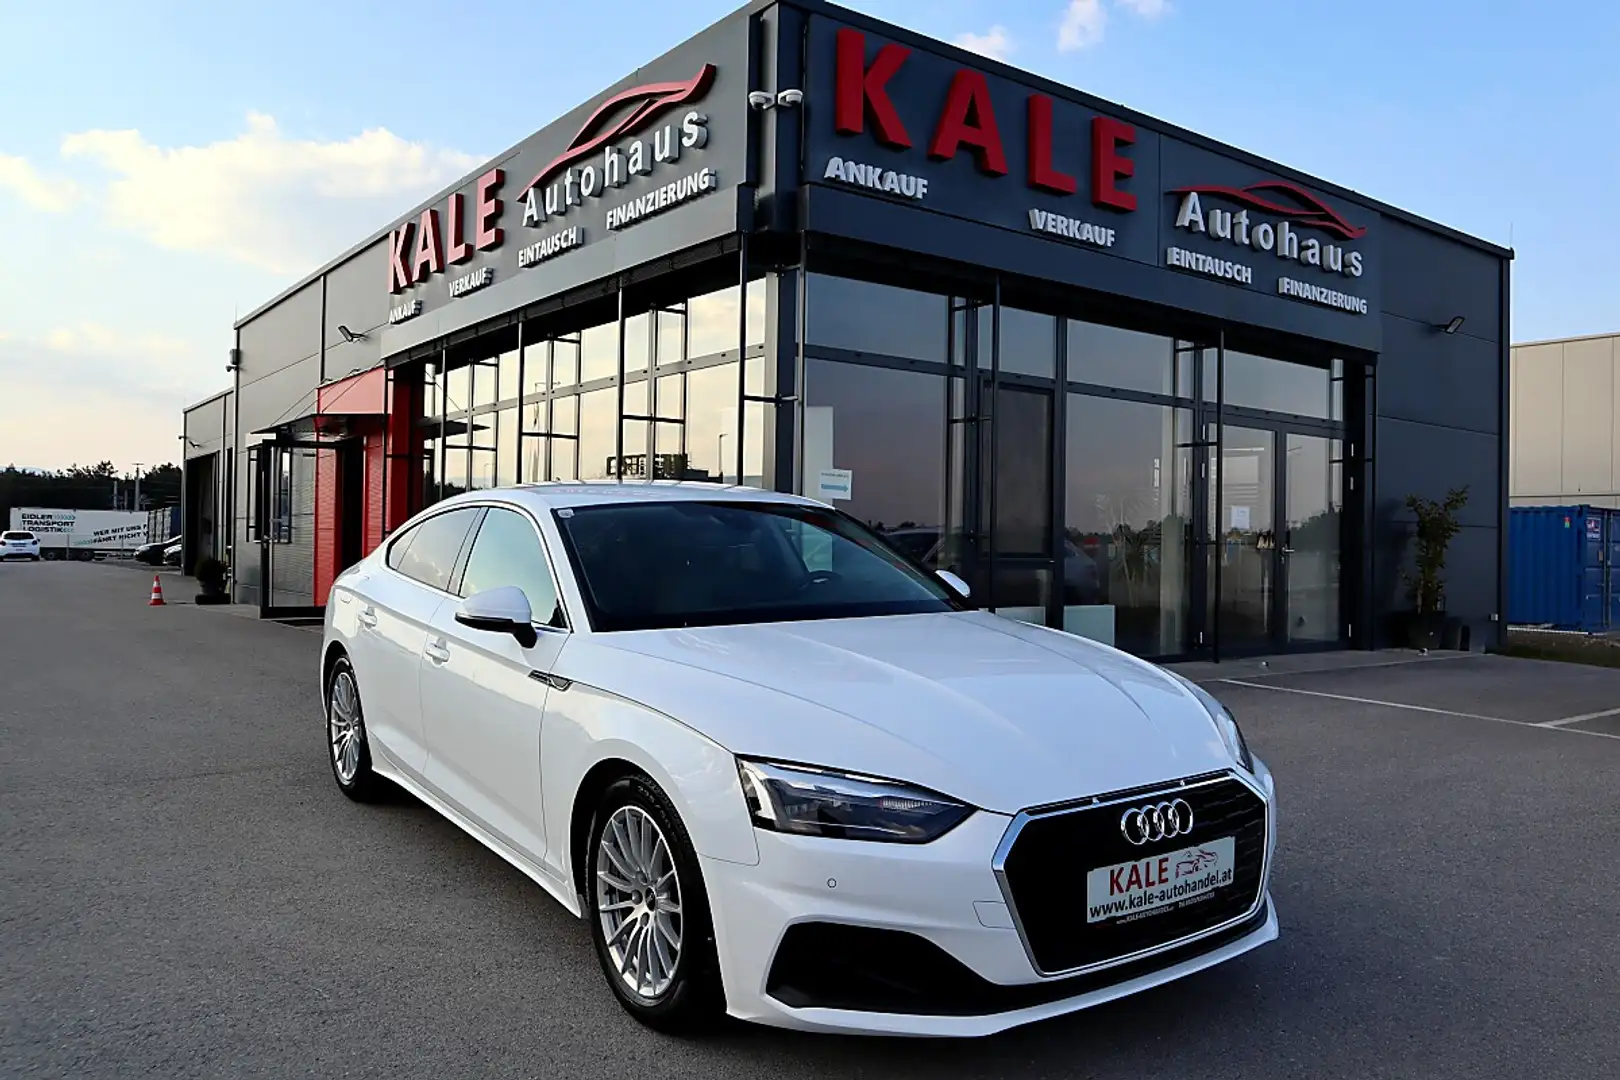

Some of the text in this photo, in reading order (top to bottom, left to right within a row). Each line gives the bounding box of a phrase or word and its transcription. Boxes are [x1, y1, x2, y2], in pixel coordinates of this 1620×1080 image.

[835, 26, 1138, 213] KALE
[522, 109, 708, 229] Autohaus
[824, 156, 1115, 248] ANKAUF VERKAUF
[389, 168, 504, 293] KALE
[518, 166, 716, 268] EINTAUSCH FINANZIERUNG
[1176, 191, 1363, 278] Autohaus
[388, 267, 493, 325] ANKAUF VERKAUF
[1166, 246, 1368, 315] EINTAUSCH FINANZIERUNG
[1089, 867, 1232, 918] www.kale-autohandel.at
[1109, 857, 1169, 896] KALE
